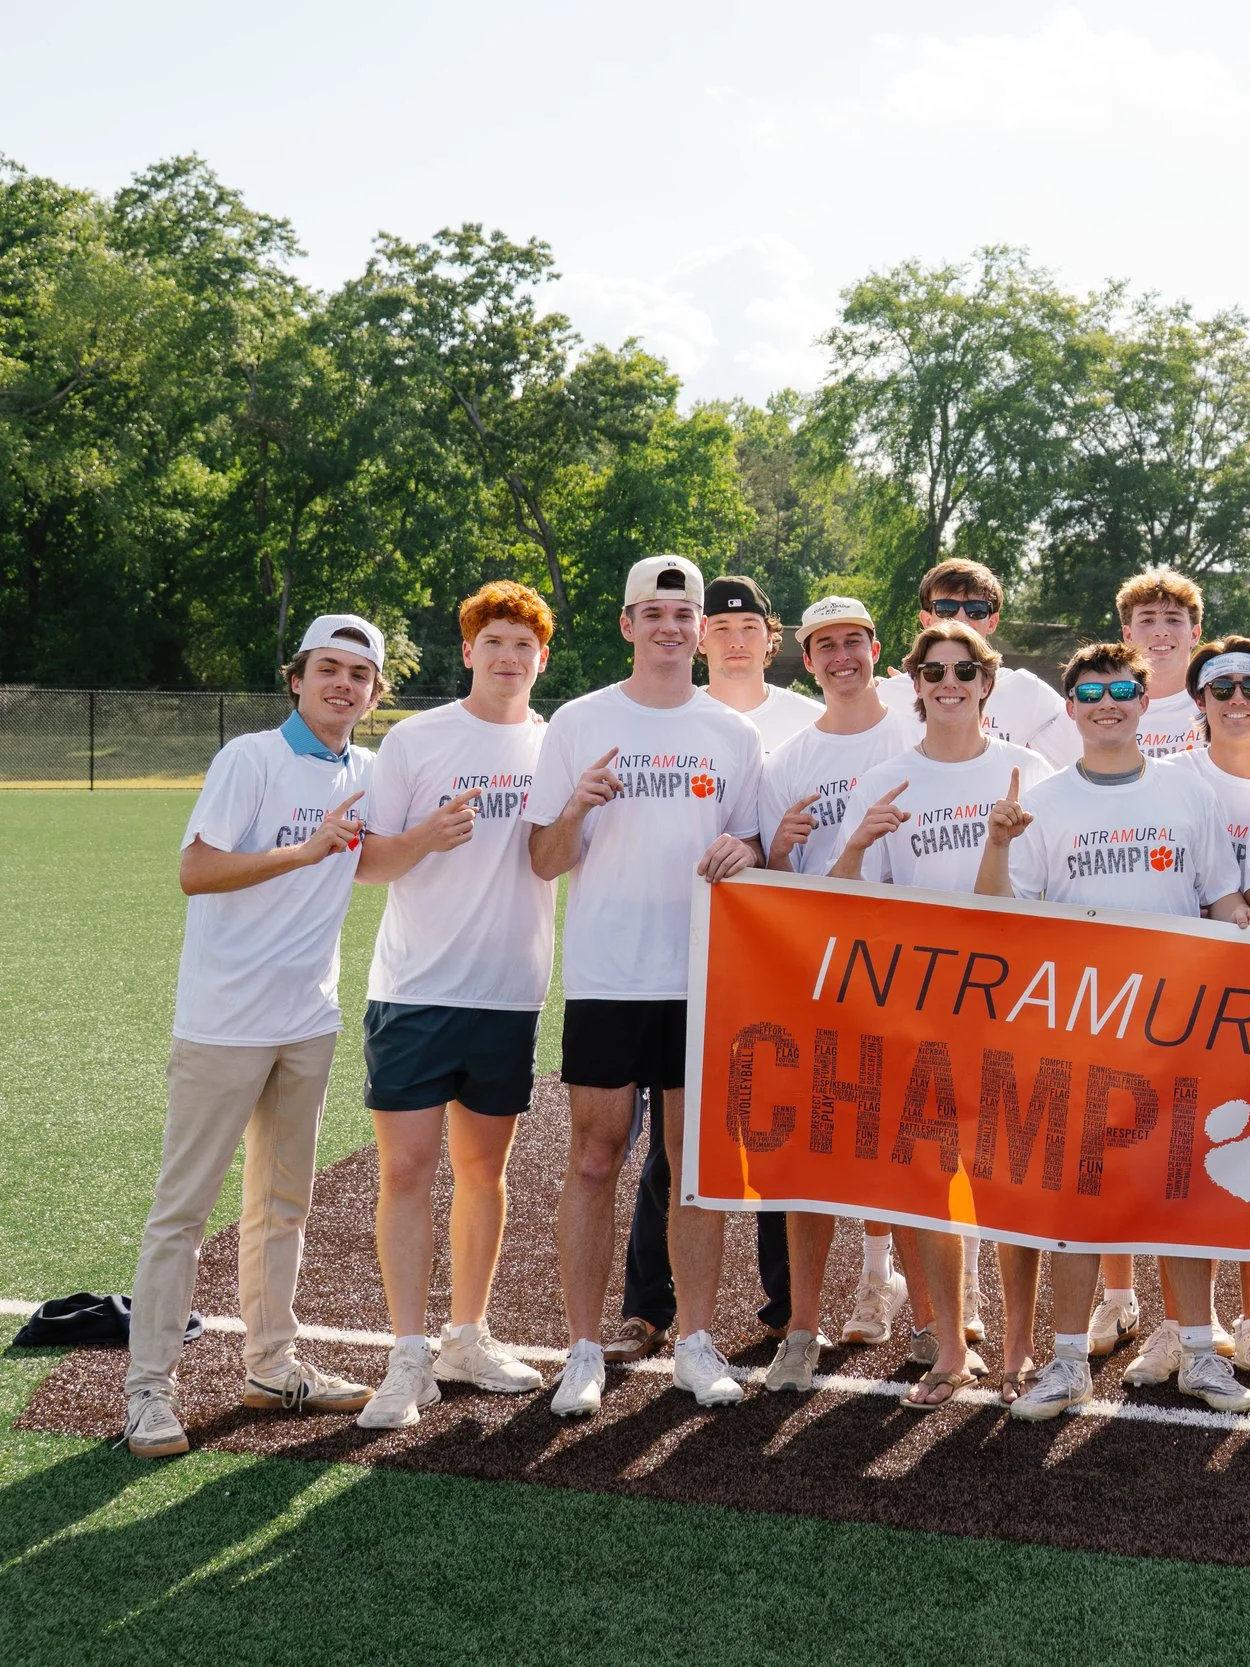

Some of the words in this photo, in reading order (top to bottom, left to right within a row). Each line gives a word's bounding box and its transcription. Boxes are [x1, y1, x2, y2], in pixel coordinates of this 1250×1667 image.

[1136, 730, 1201, 745] RAMURAL
[614, 755, 716, 771] INTRAMURAL
[453, 774, 532, 789] INTRAMUR
[614, 772, 726, 803] HAMPIN
[918, 803, 996, 827] INTRAMU
[910, 822, 986, 858] CHAMP
[1074, 827, 1175, 849] INTRAMURAL
[1067, 846, 1186, 880] CHAMPIN
[816, 1028, 838, 1037] TENNIS
[861, 1034, 884, 1042] EFFORT
[815, 1045, 837, 1055] FLAG
[920, 1041, 948, 1049] COMPETE
[776, 1048, 799, 1058] FLAG
[918, 1047, 950, 1057] KICKBALL
[1040, 1057, 1072, 1069] COMPETE
[1040, 1066, 1073, 1078] KICKBALL
[1089, 1065, 1112, 1074] TENNIS
[739, 1051, 754, 1116] VOLLEYBALL
[820, 1080, 858, 1090] SPIKEBALL
[910, 1077, 930, 1088] PLAY
[1002, 1080, 1016, 1090] FUN
[1035, 1079, 1071, 1090] VOLLEYBALL
[1088, 1072, 1120, 1082] VOLLEYBALL
[1122, 1077, 1151, 1088] FRISBEE
[1050, 1088, 1069, 1099] FLAG
[1087, 1089, 1109, 1098] EFFORT
[1174, 1088, 1198, 1099] FLAG
[858, 1101, 880, 1112] FLAG
[979, 1096, 1000, 1107] PLAY
[1029, 1102, 1045, 1112] PLAY
[1086, 1101, 1108, 1111] TENNIS
[811, 1095, 820, 1129] RESPECT
[821, 1095, 834, 1121] PLAY
[903, 1107, 923, 1117] FLAG
[937, 1104, 956, 1117] FUN
[1005, 1104, 1019, 1112] FLAG
[856, 1130, 873, 1140] FUN
[900, 1122, 944, 1136] BATTLESHIP
[944, 1128, 959, 1138] FUN
[1106, 1127, 1150, 1140] RESPECT
[1171, 1130, 1194, 1138] TENNIS
[1046, 1134, 1065, 1145] FLAG
[980, 1126, 991, 1165] SPIKEBALL
[891, 1153, 912, 1165] PLAY
[973, 1163, 992, 1175] FLAG
[1080, 1160, 1103, 1174] FUN
